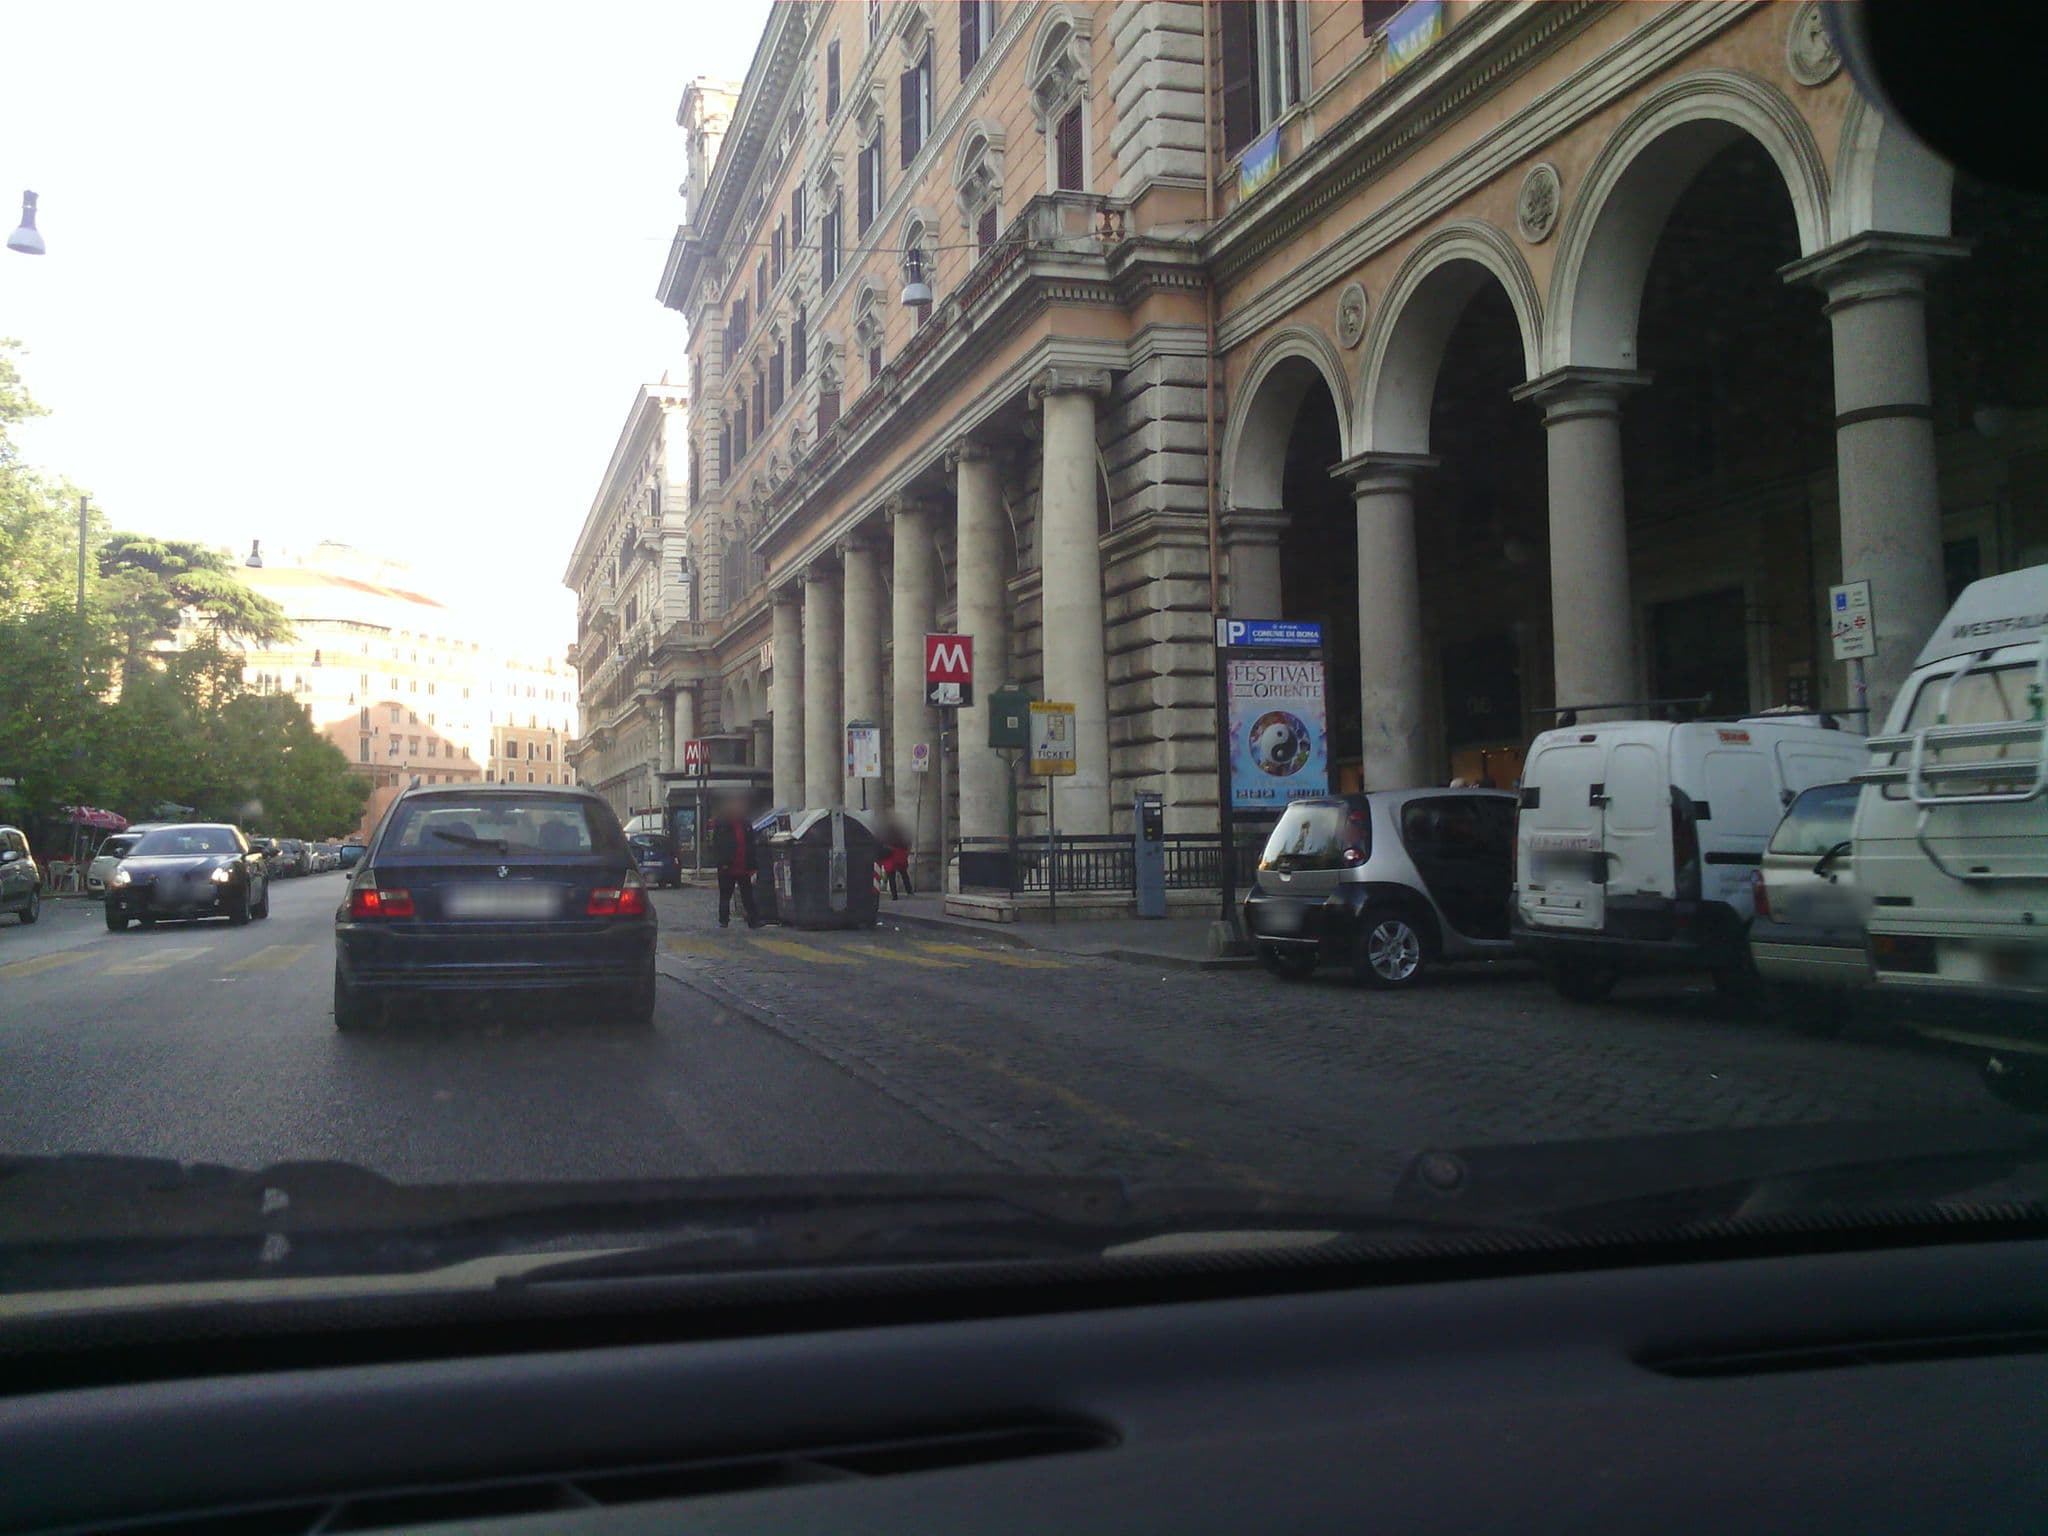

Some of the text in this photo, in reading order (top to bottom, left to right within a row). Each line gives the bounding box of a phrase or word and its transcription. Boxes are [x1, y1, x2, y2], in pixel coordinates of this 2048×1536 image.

[1228, 622, 1246, 644] P
[1252, 630, 1284, 638] COMUNE
[929, 643, 969, 673] M
[1234, 665, 1320, 683] FESTIVAL
[1254, 683, 1320, 698] ORIENTE
[686, 744, 699, 760] M
[1037, 751, 1069, 759] TICKET
